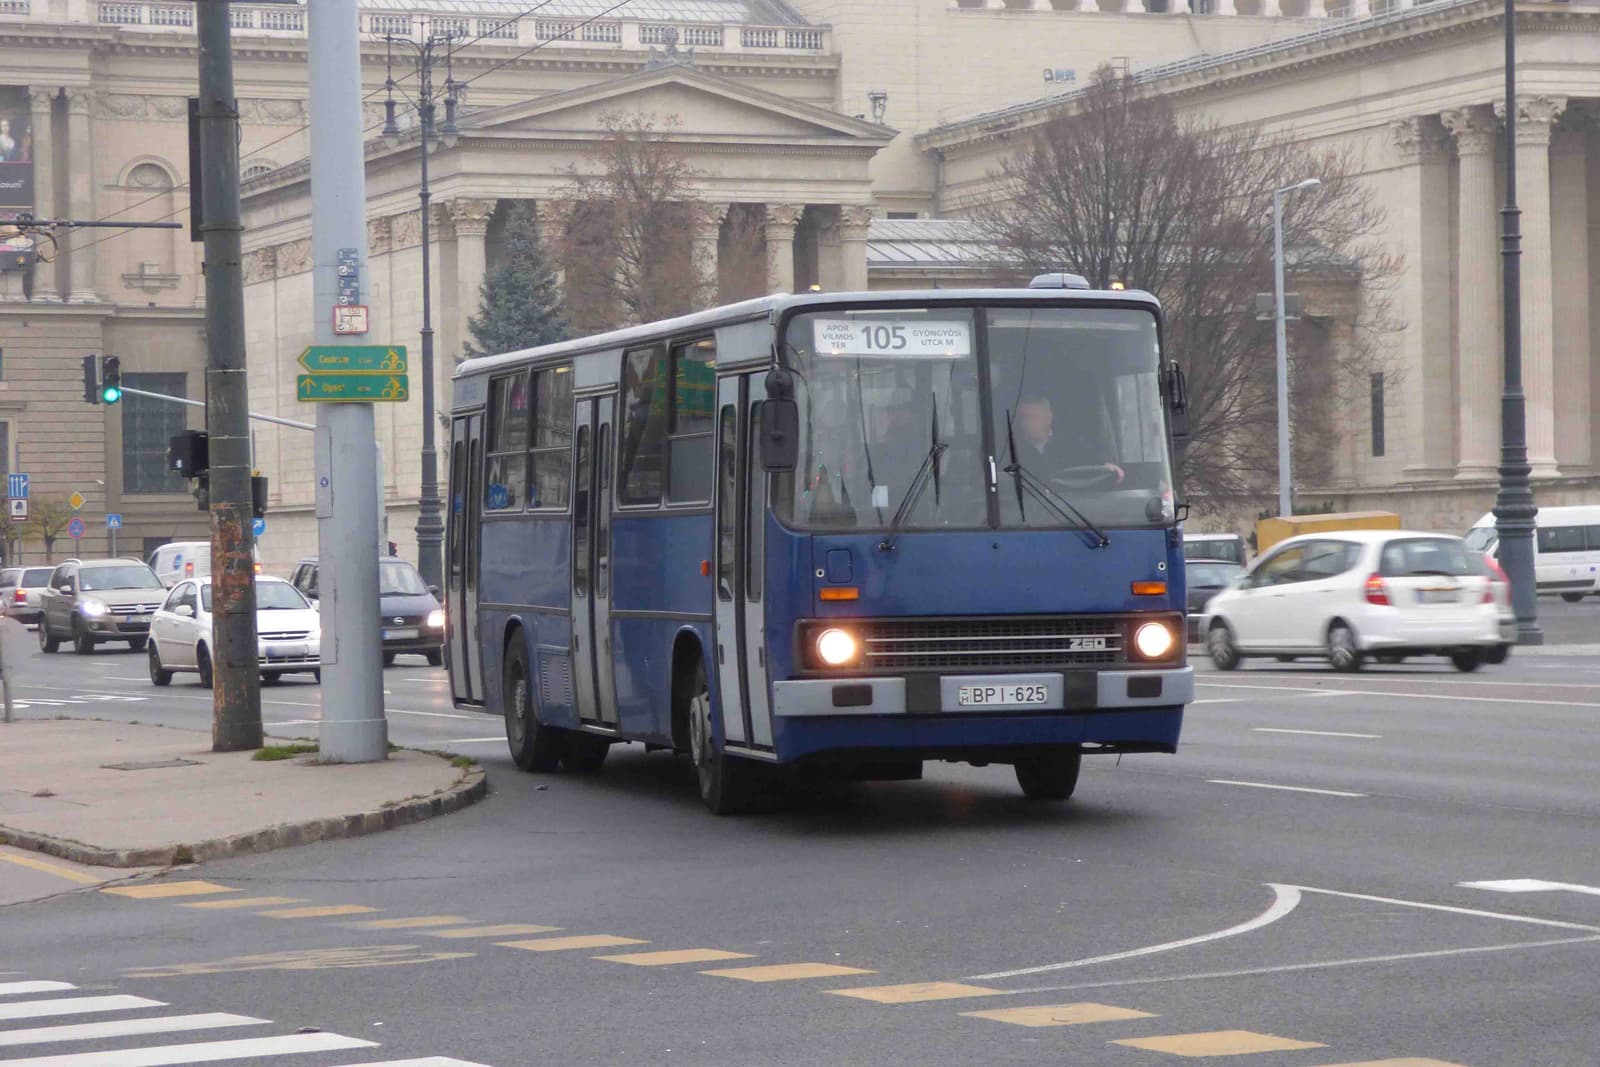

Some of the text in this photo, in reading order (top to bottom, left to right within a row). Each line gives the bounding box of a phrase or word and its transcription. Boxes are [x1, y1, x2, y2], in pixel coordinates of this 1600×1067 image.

[826, 324, 849, 332] APOR
[822, 332, 854, 341] VILMOS
[861, 325, 907, 350] 105
[831, 340, 847, 349] TÉR
[921, 338, 954, 346] UTCA M
[973, 686, 1046, 703] BPI-625
